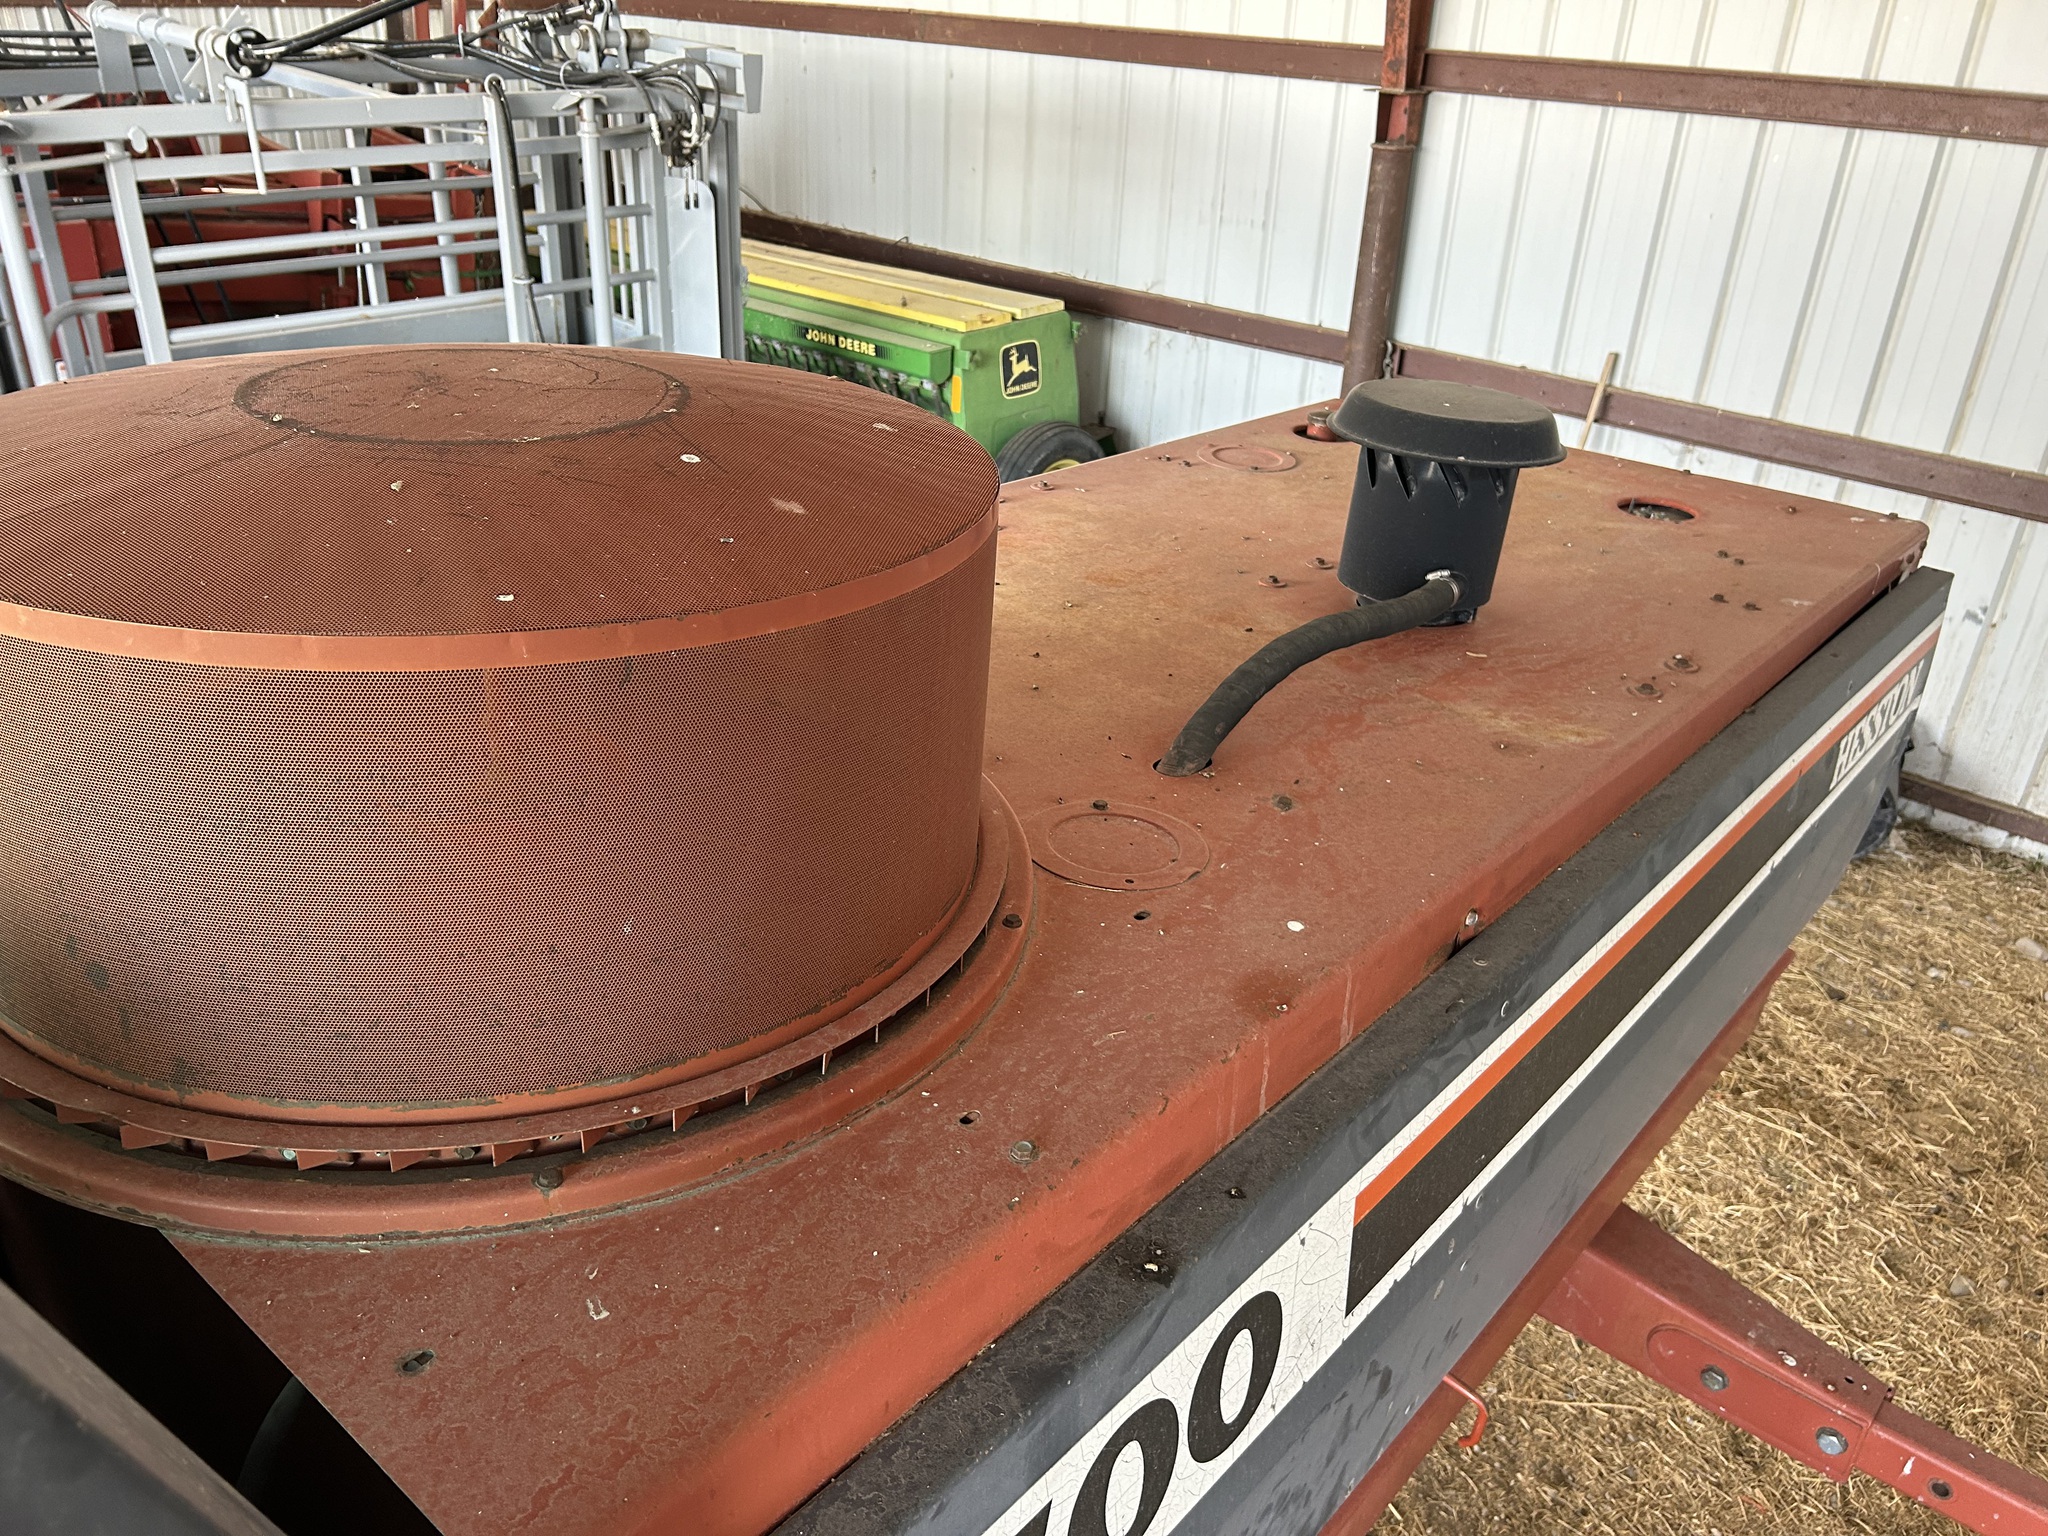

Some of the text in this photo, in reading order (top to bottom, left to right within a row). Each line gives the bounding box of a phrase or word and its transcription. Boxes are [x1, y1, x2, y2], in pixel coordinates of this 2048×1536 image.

[806, 329, 876, 356] JOHN DEERE
[1829, 658, 1925, 791] HESSTON
[1015, 1291, 1282, 1536] 00
